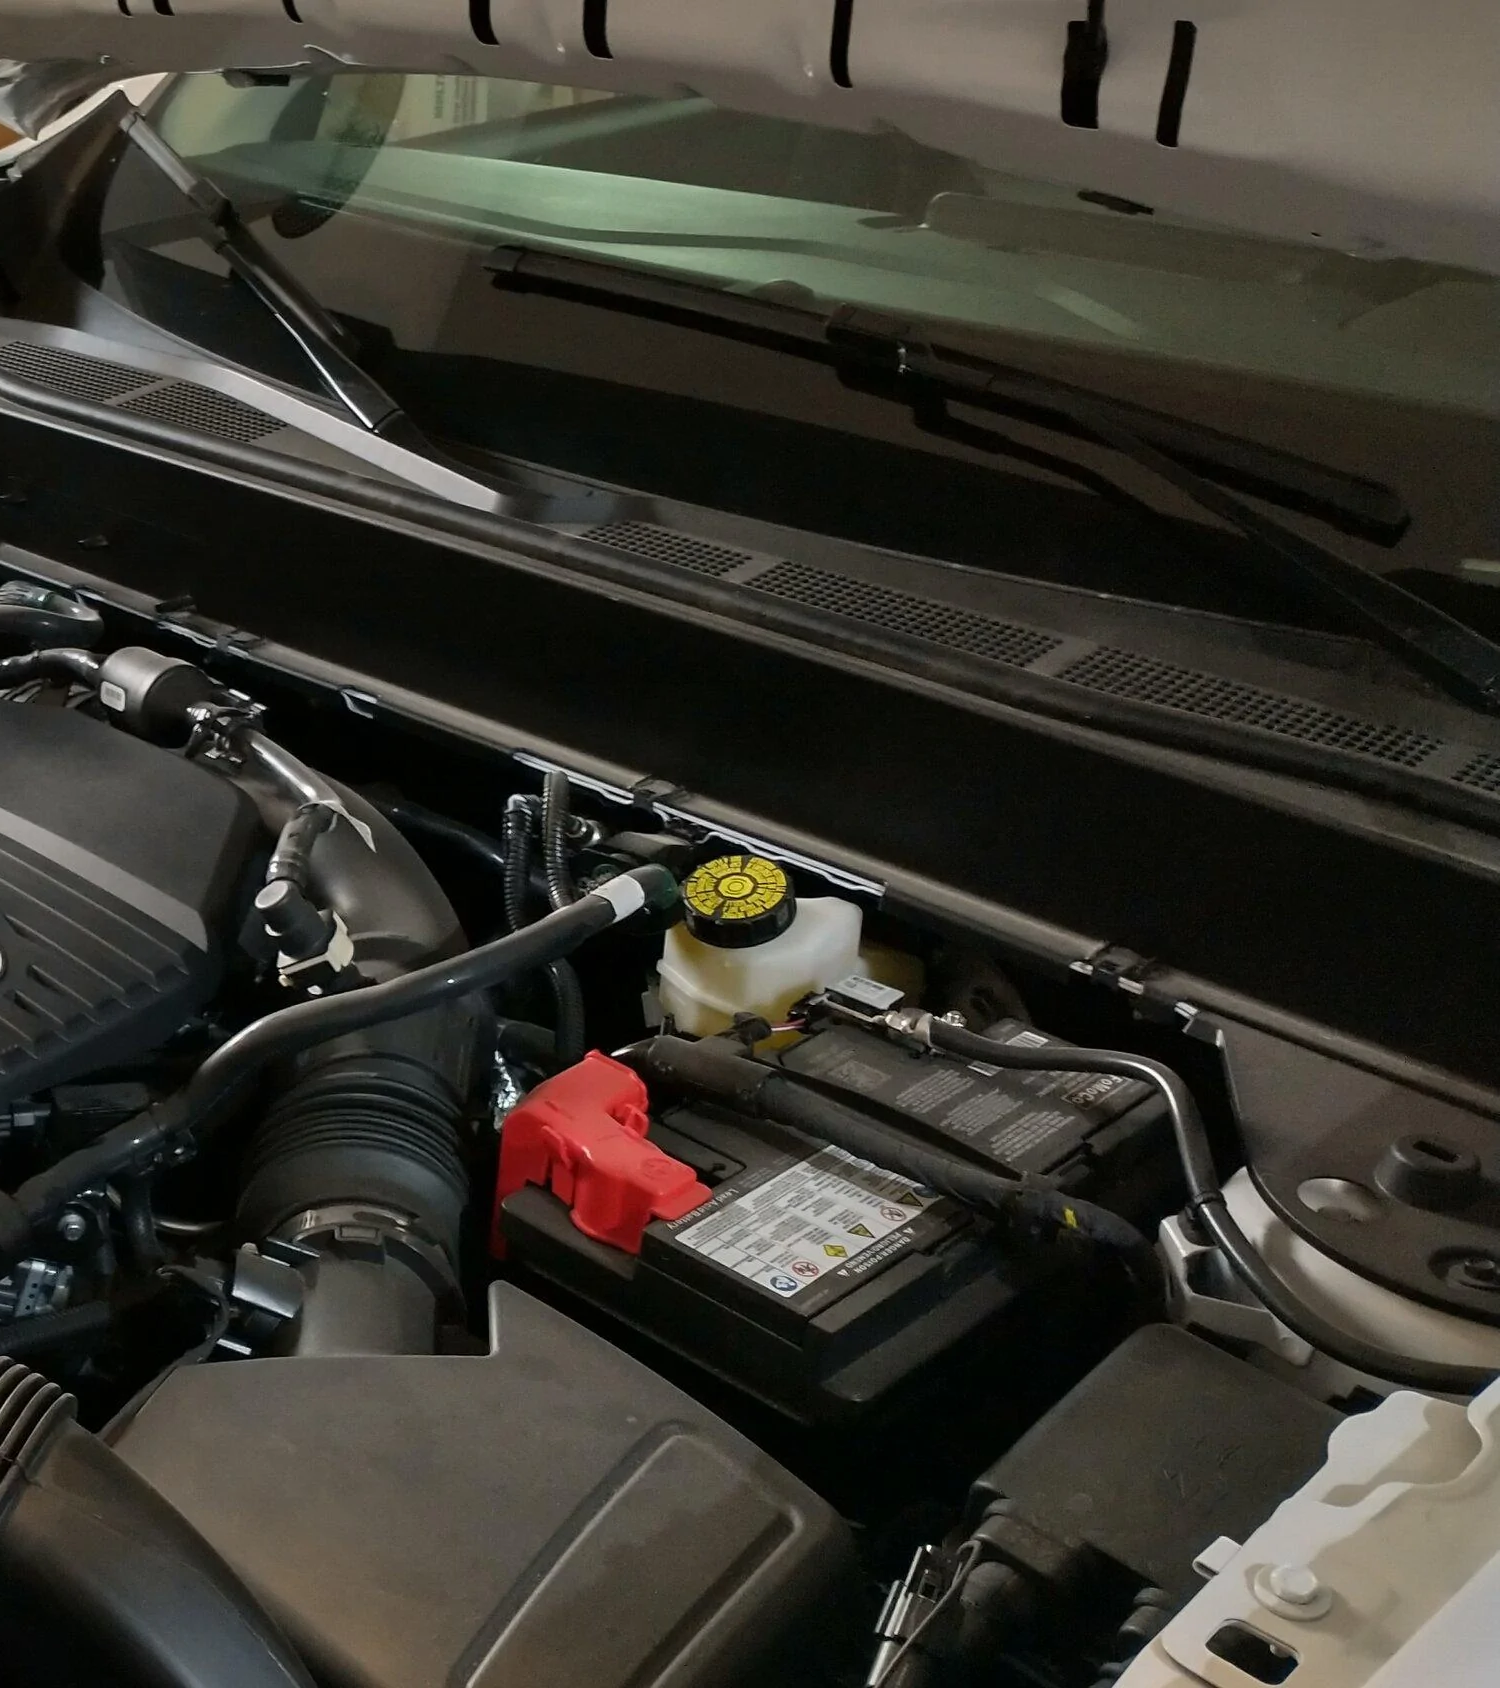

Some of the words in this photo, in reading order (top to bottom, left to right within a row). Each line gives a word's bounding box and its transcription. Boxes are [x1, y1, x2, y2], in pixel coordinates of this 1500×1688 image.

[1071, 1074, 1123, 1103] FoMoCo
[697, 1198, 719, 1214] Acid
[715, 1188, 739, 1207] Lead
[666, 1209, 701, 1230] Battery
